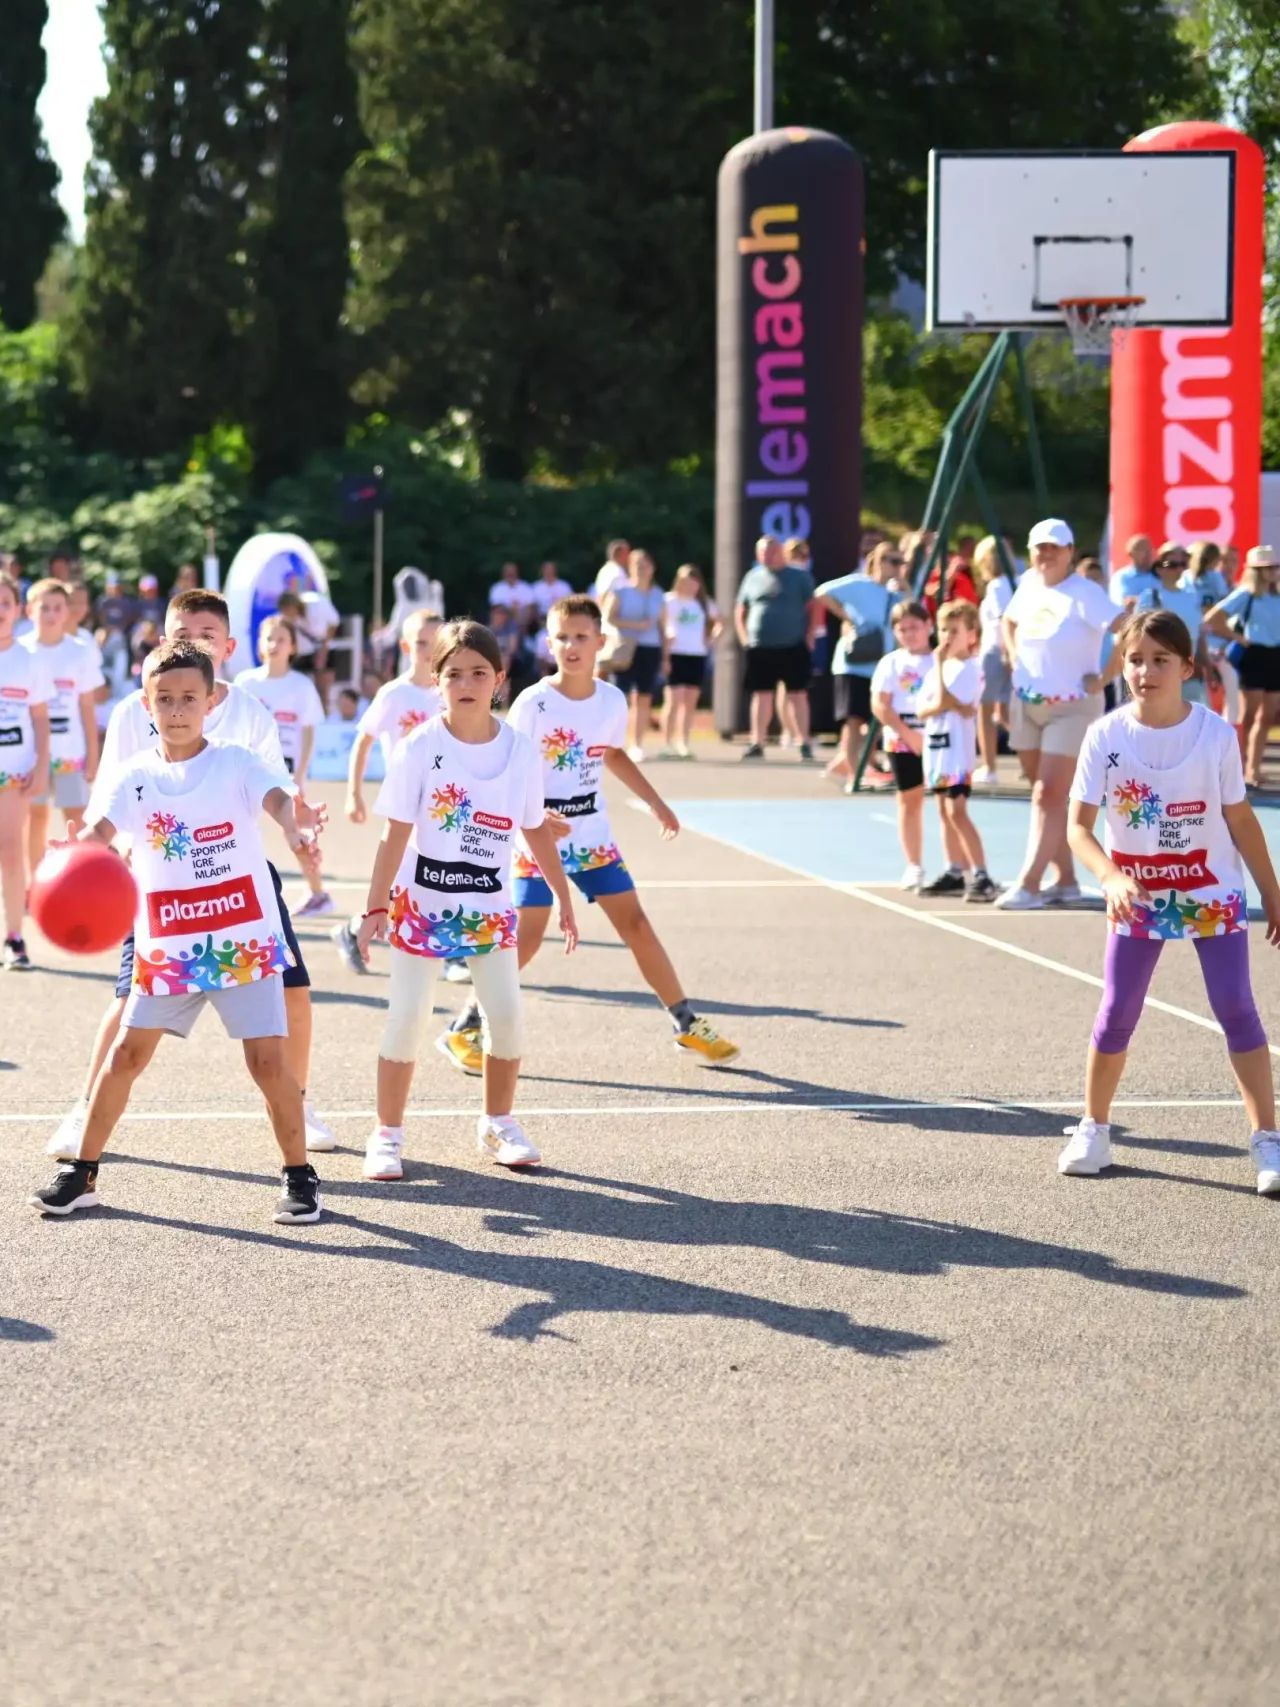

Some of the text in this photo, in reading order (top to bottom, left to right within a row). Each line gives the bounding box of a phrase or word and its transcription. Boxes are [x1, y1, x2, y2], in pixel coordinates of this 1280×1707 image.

[738, 204, 811, 542] elemach
[1169, 803, 1201, 815] plazma
[476, 814, 509, 828] plazma
[197, 825, 229, 841] plazma
[463, 824, 510, 842] SPORTSKE
[1159, 830, 1181, 840] IGRE
[190, 839, 237, 858] SPORTSKE
[460, 845, 494, 859] MLADIH
[192, 857, 214, 869] IGRE
[1121, 862, 1204, 880] plazma
[195, 864, 231, 880] MLADIH
[422, 866, 494, 887] telemach
[159, 893, 246, 927] plazma
